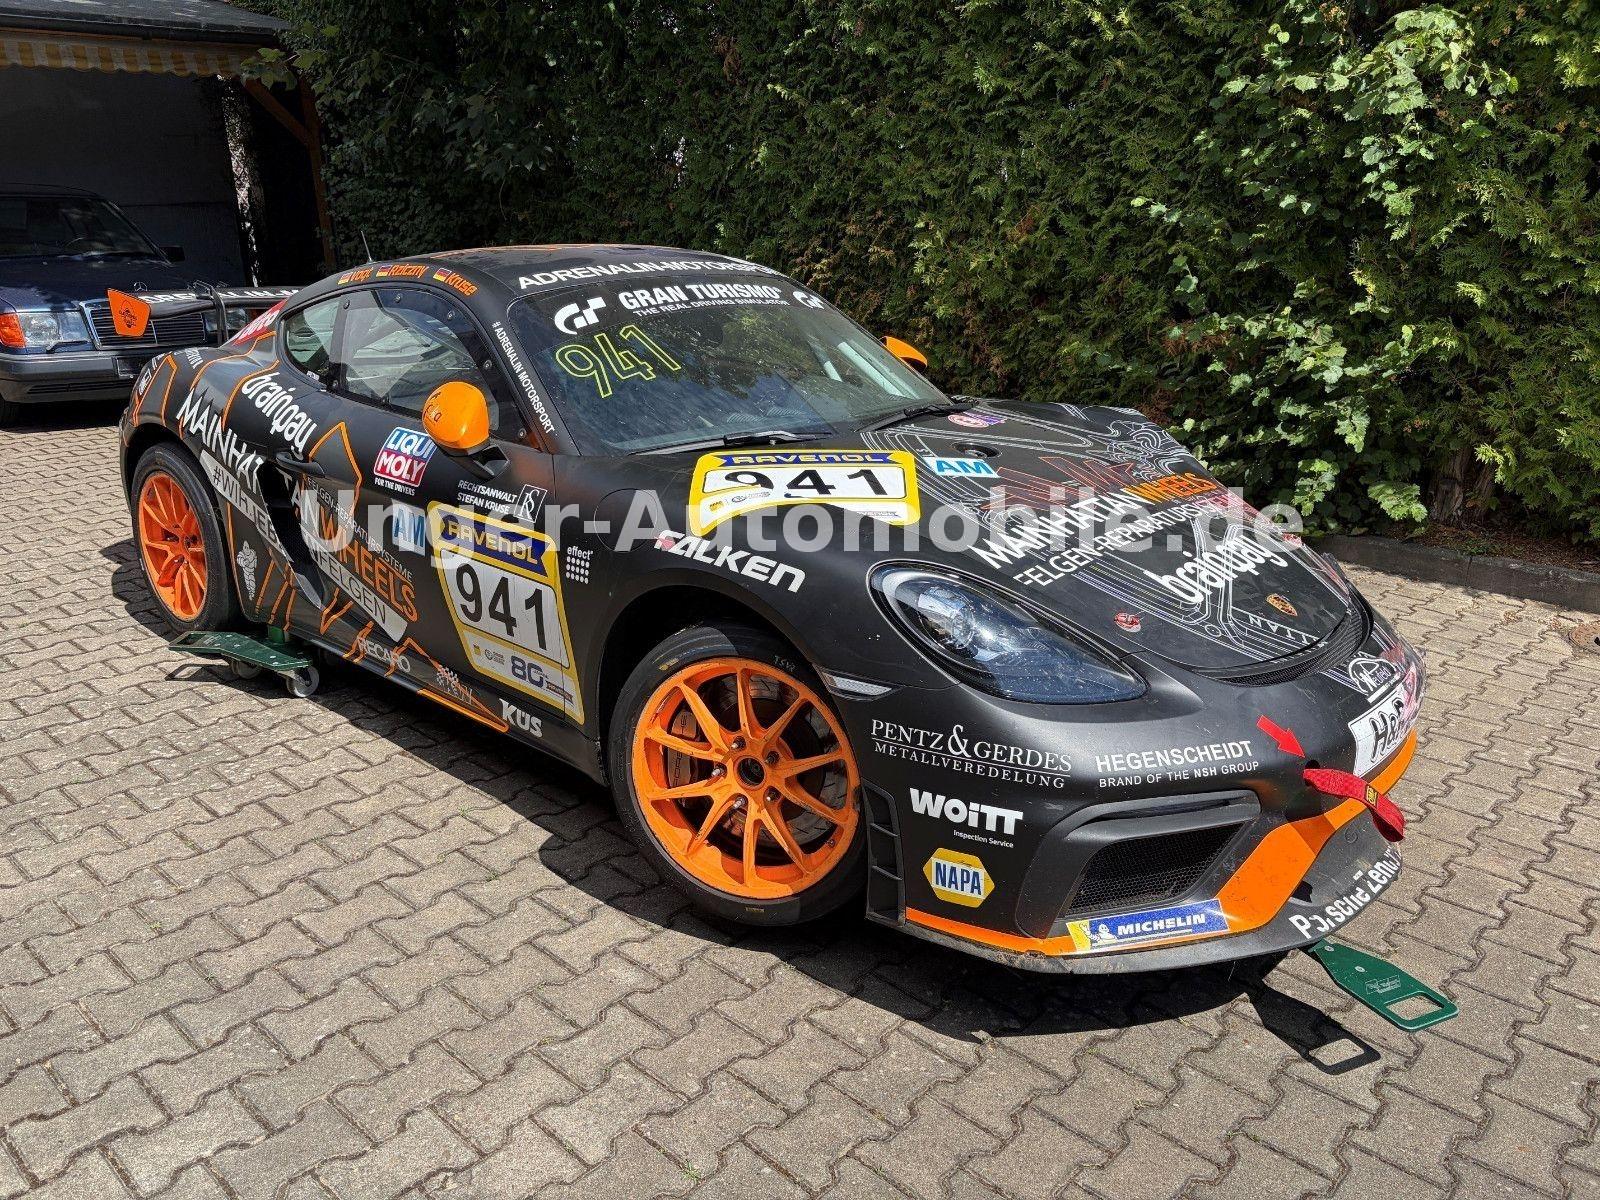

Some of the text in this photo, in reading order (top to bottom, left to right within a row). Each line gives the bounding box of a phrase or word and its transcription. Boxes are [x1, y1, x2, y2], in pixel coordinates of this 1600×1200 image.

[444, 273, 478, 296] Kruse
[618, 285, 690, 310] GRAN
[633, 309, 661, 318] THE
[660, 304, 692, 315] REAL
[691, 299, 736, 309] DRIVING
[556, 324, 681, 398] 941
[491, 321, 556, 434] #ADRENALIN MOTORSPORT
[241, 372, 317, 460] brainpay
[385, 430, 438, 458] LIQUI
[731, 454, 884, 464] RAVENOL
[377, 452, 425, 483] MOLY
[724, 469, 889, 496] 941
[935, 459, 994, 475] AM
[374, 477, 416, 497] FOR THE DRIVERS
[457, 479, 518, 503] RECHTSANWALT
[457, 492, 511, 515] STEFAN KRUSE
[393, 508, 425, 548] AM
[449, 522, 538, 565] RAVENOL
[654, 530, 806, 593] FALKEN
[1143, 535, 1289, 604] brainpay
[455, 563, 547, 651] 941
[499, 698, 543, 738] KÜS
[871, 719, 1072, 772] PENTZ & GERDES
[1095, 741, 1253, 773] HEGENSCHEIDT
[874, 742, 1065, 789] METALLVEREDELUNG
[1099, 761, 1259, 788] BRAND OF THE NSH GROUP
[953, 830, 1014, 849] Inspection Service
[935, 861, 982, 896] NAPA
[1117, 913, 1206, 937] MICHELIN
